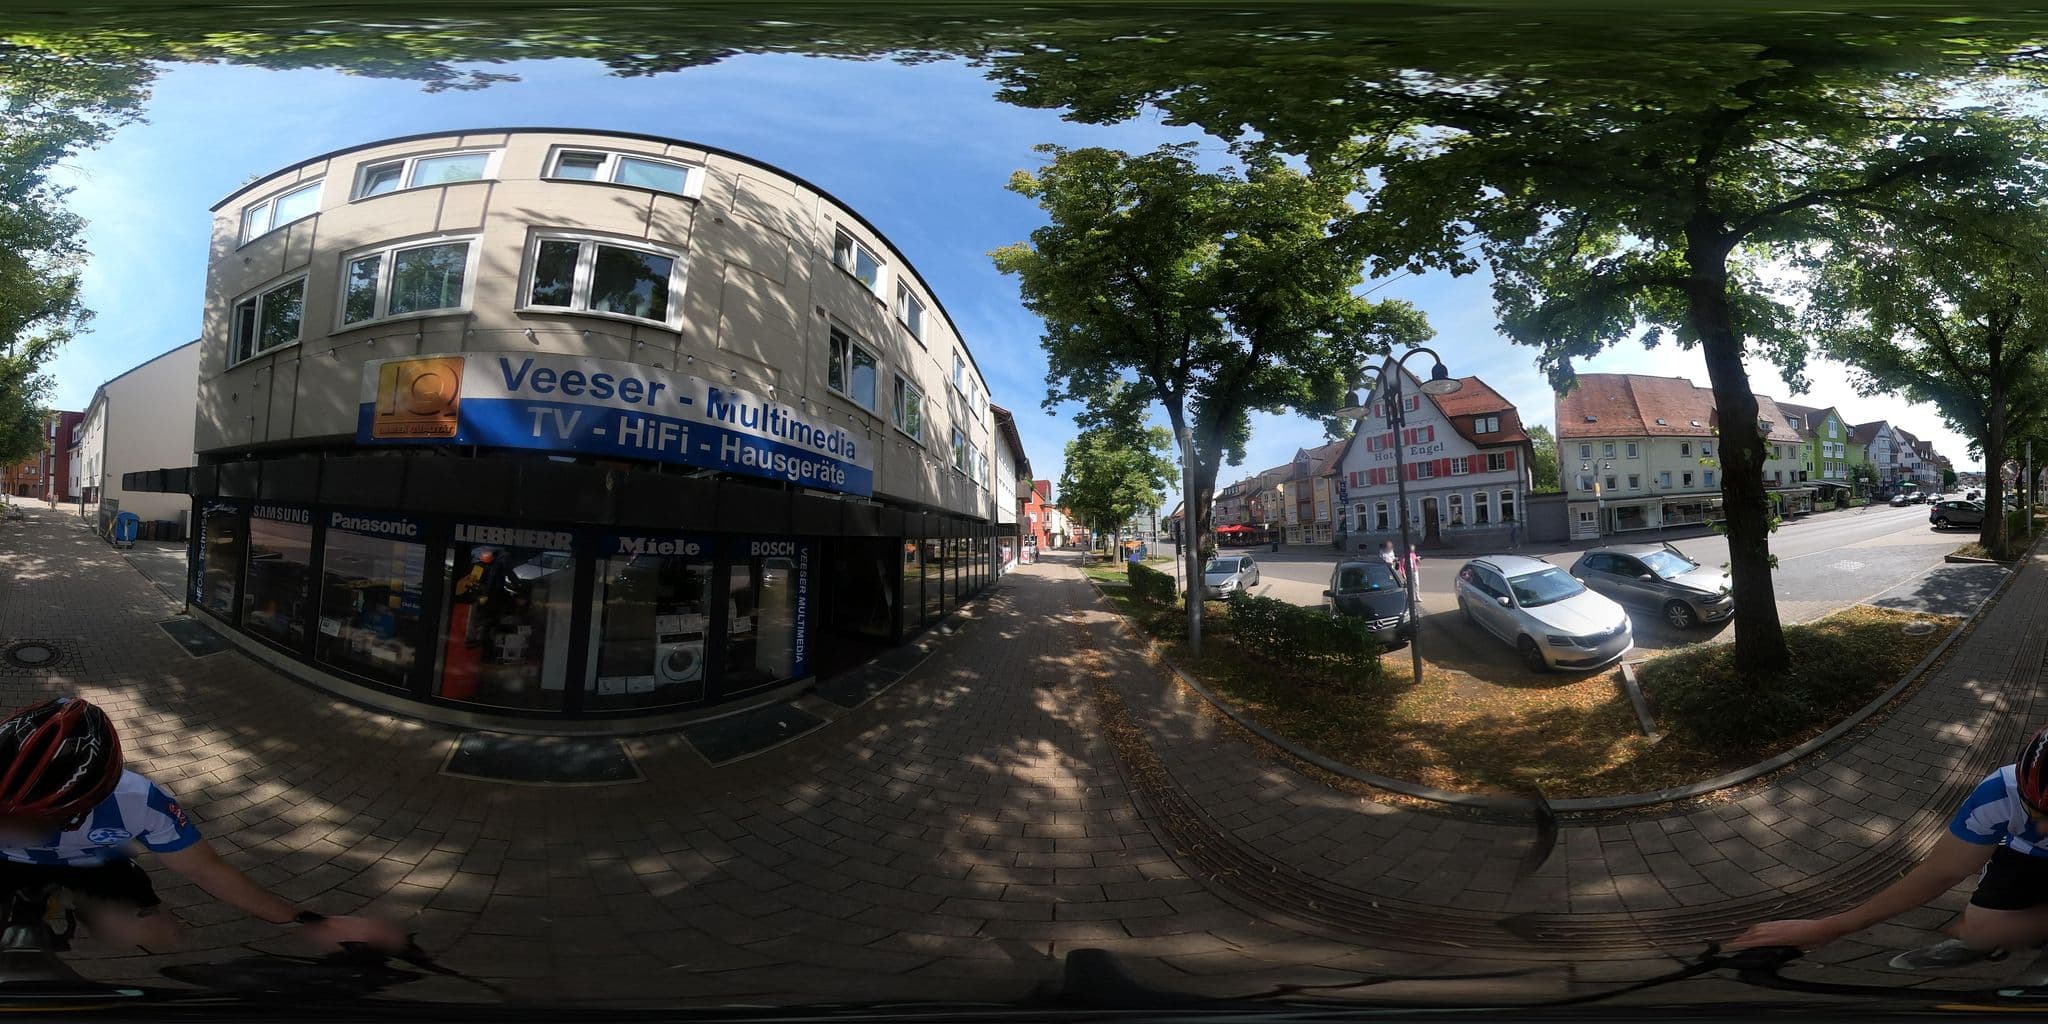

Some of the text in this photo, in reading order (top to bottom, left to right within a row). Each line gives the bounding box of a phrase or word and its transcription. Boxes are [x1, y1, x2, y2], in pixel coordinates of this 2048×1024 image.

[499, 357, 856, 460] Veeser - Multimedia
[527, 406, 845, 485] TV - HiFi - Hausgeräte
[1410, 442, 1444, 456] Engel
[253, 504, 310, 523] SAMSUNG
[331, 512, 417, 537] Panasonic
[455, 524, 573, 550] LIEBHERR
[618, 536, 701, 556] Miele
[751, 541, 795, 556] BOSCH
[195, 570, 205, 603] HEOS
[795, 547, 809, 664] VEESER MULTIMEDIA
